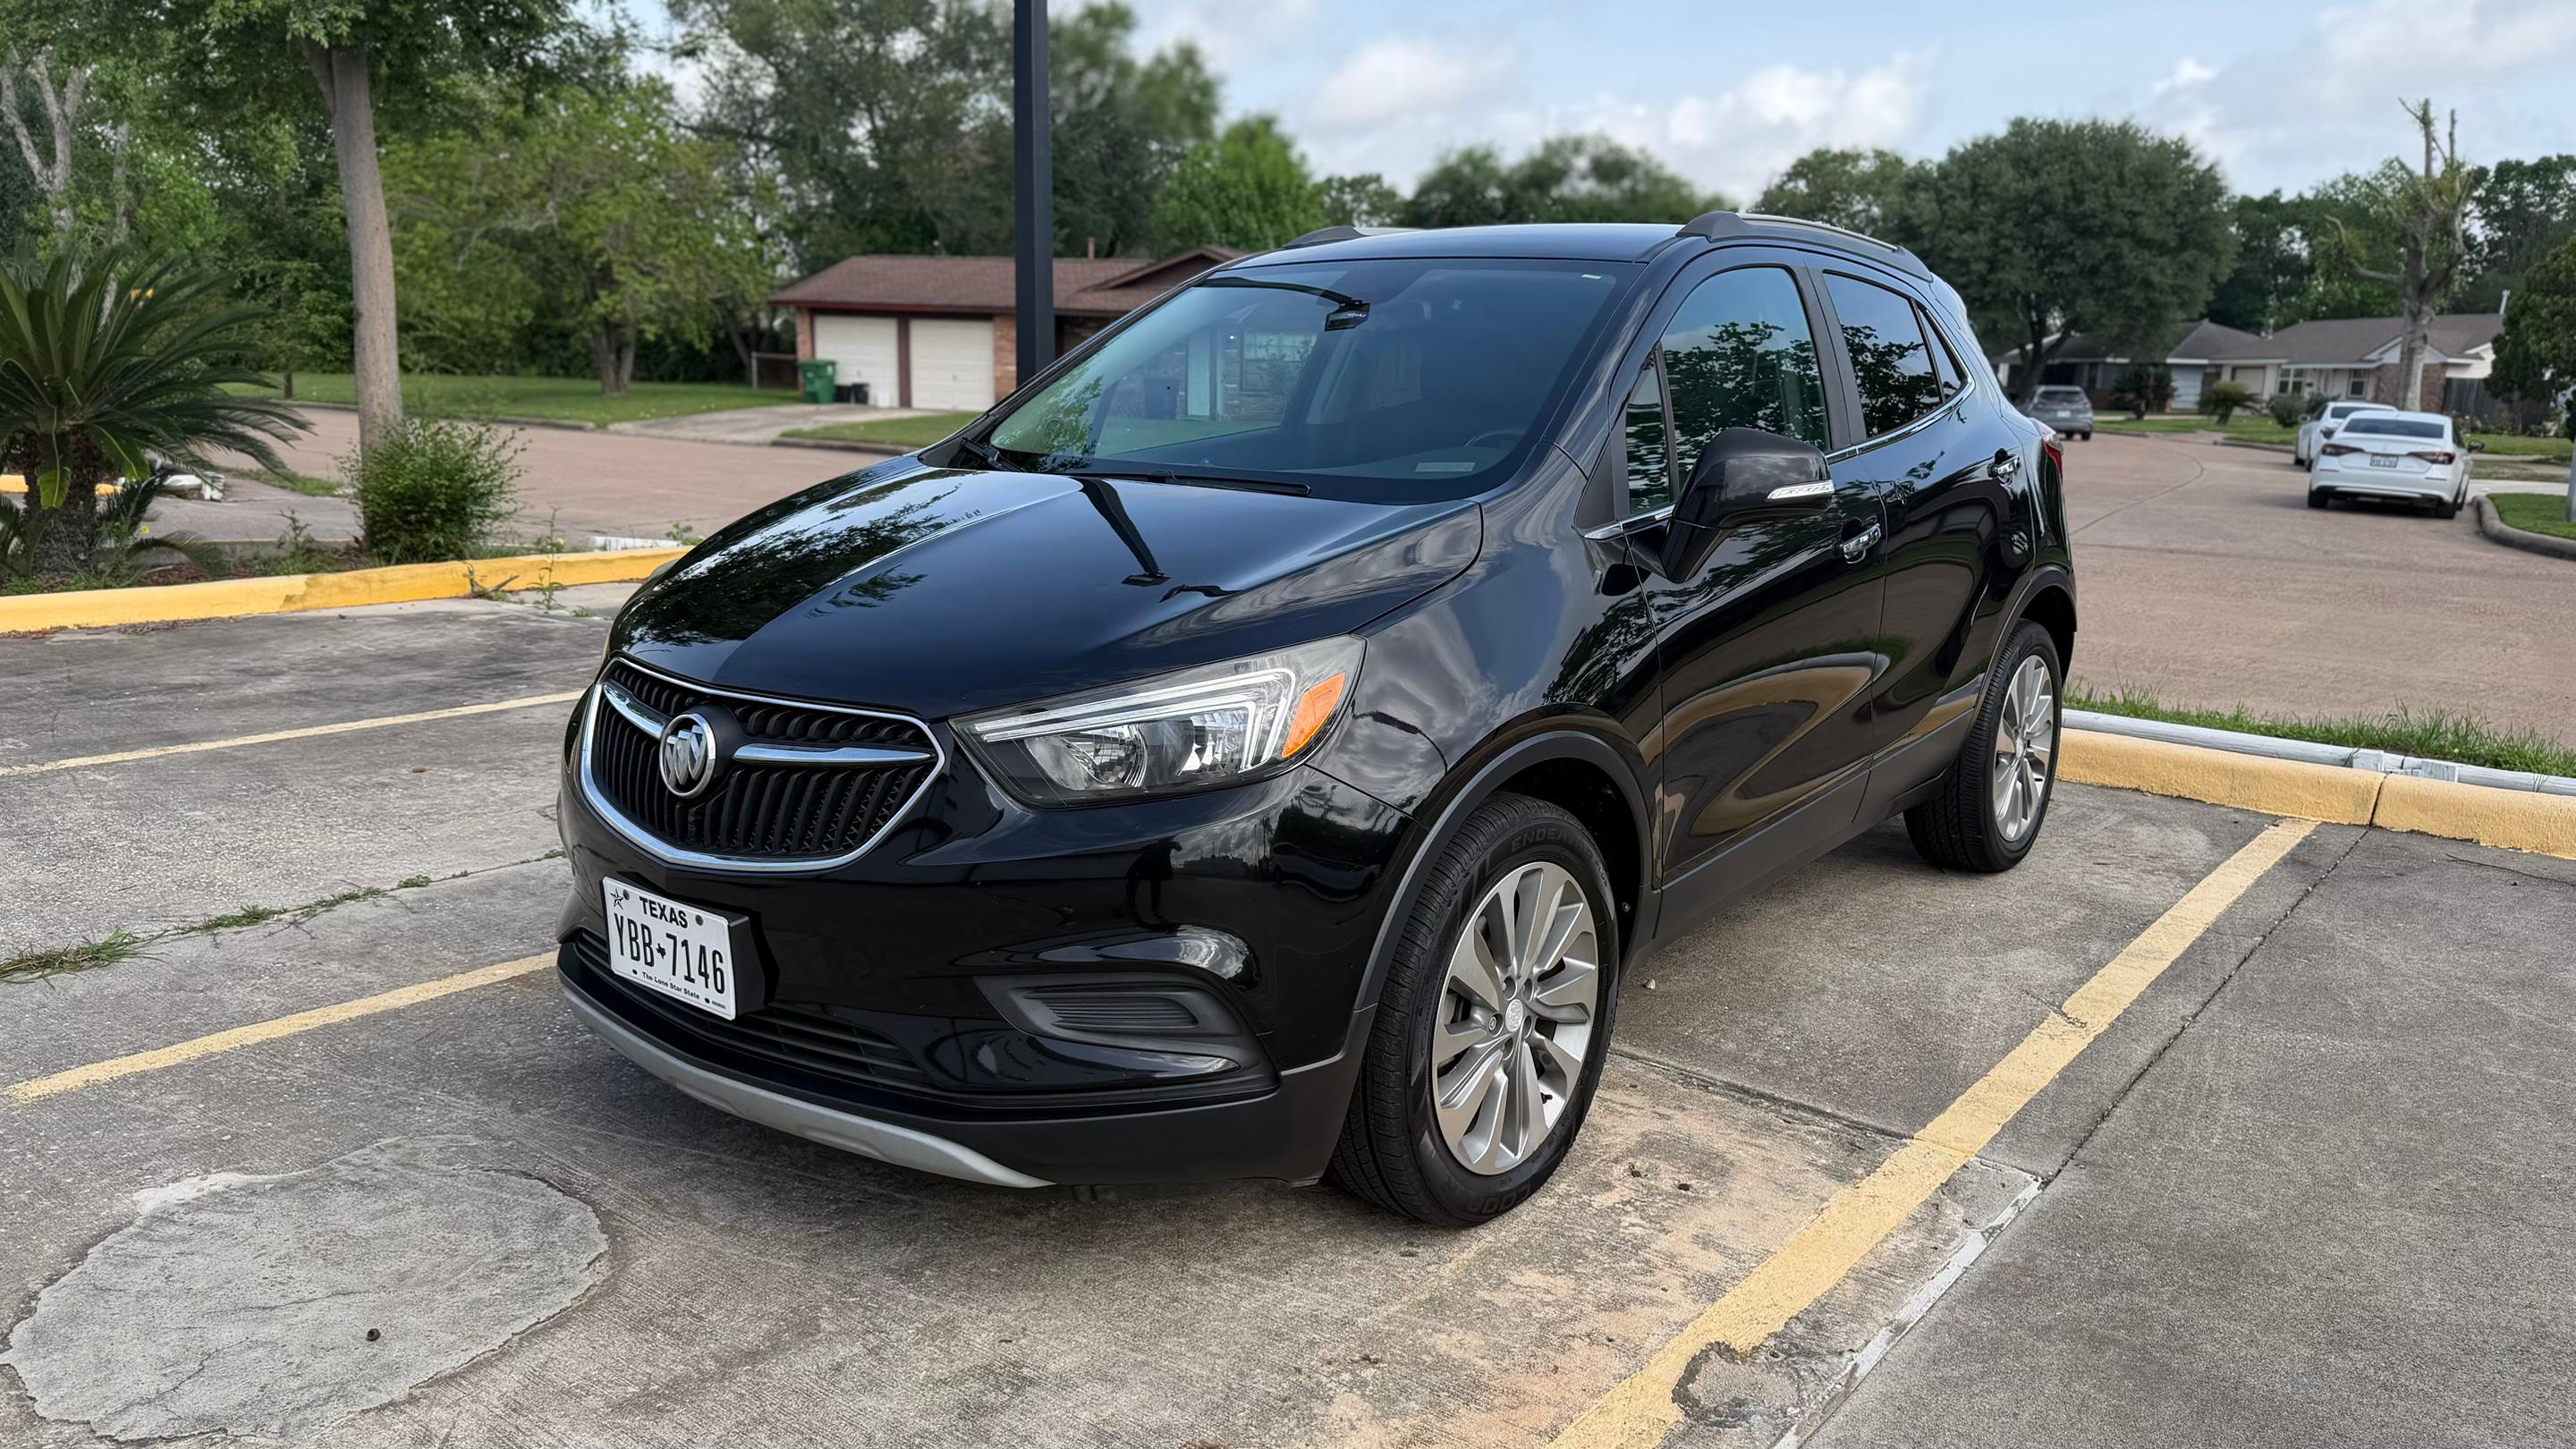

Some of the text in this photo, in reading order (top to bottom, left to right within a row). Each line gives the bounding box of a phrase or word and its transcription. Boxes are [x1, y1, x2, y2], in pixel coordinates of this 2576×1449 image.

[640, 896, 688, 928] TEXAS
[642, 971, 700, 1000] The Lone Star State
